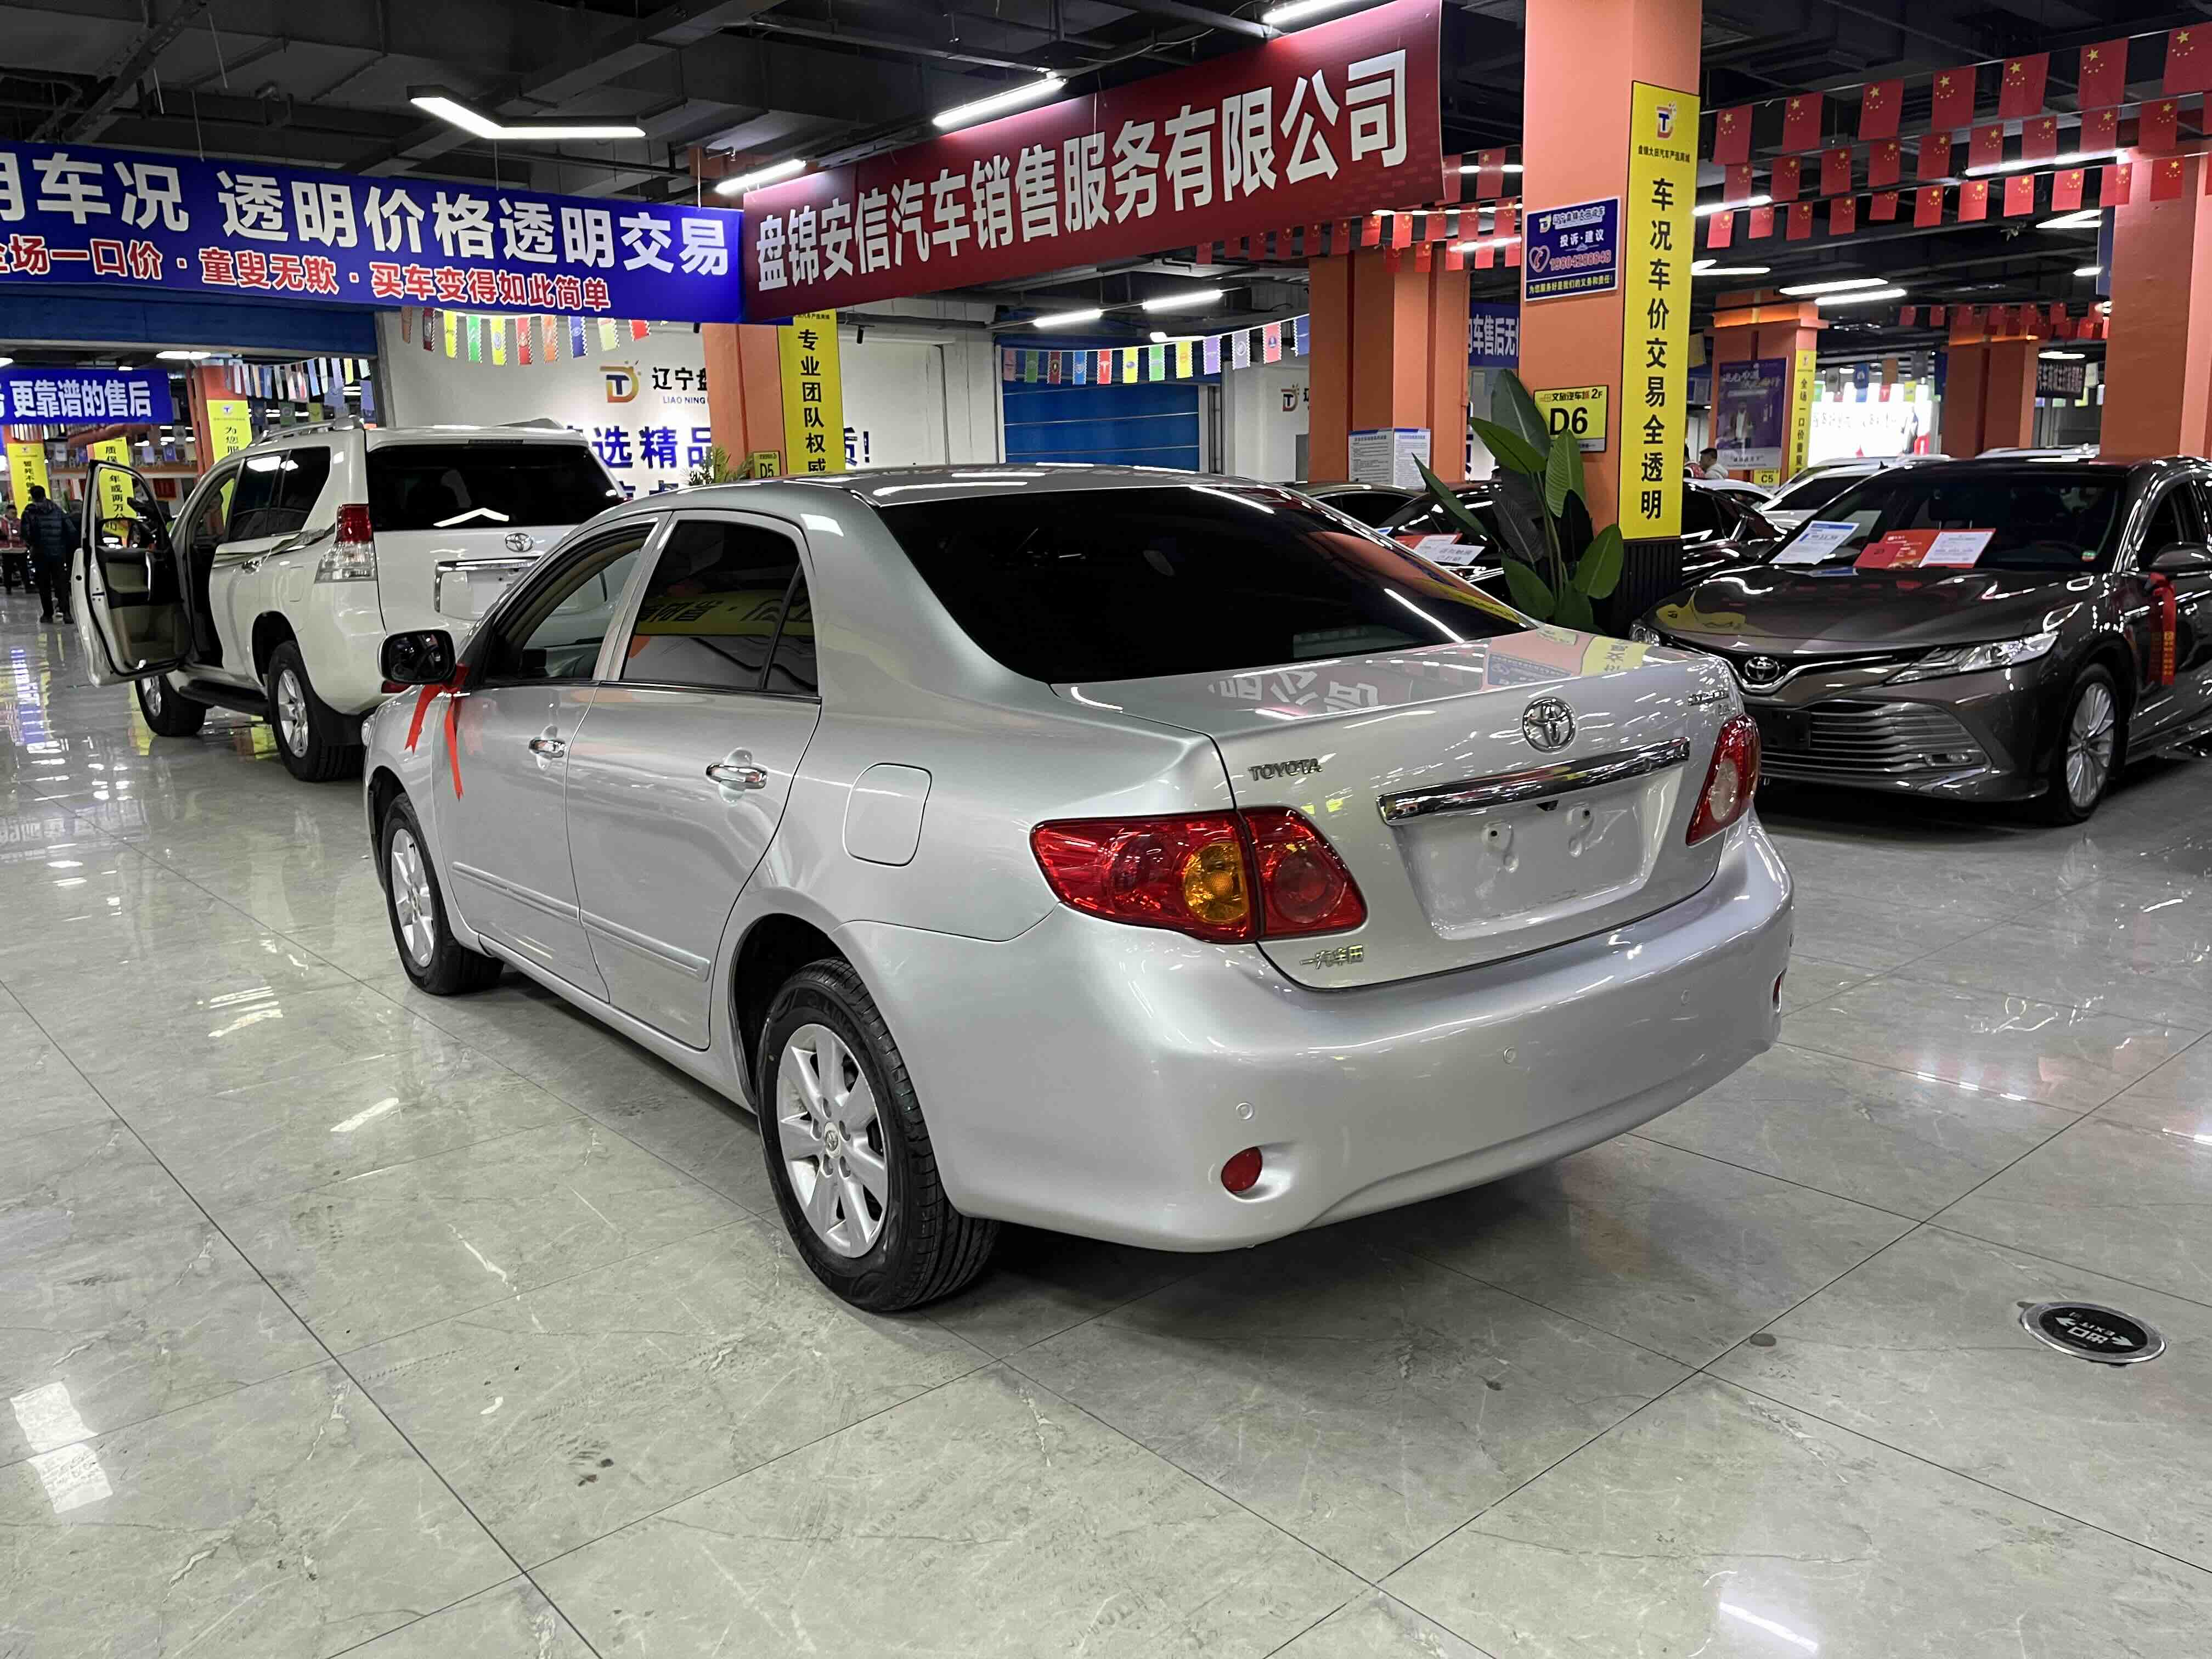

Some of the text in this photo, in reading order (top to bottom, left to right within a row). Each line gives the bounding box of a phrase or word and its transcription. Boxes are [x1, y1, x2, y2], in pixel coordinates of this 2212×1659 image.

[756, 49, 1408, 291] 盘锦安信汽车销售服务有限公司
[217, 169, 729, 276] 透明价格透明交易
[1469, 314, 1519, 357] 车售后无
[1640, 178, 1674, 520] 车况车价交易全透明
[9, 379, 152, 417] 更靠谱的售后
[663, 396, 682, 404] LIAO
[1550, 407, 1588, 436] D6
[566, 425, 712, 469] 选精品
[1761, 475, 1774, 483] C5
[1248, 758, 1322, 782] TOYOTA
